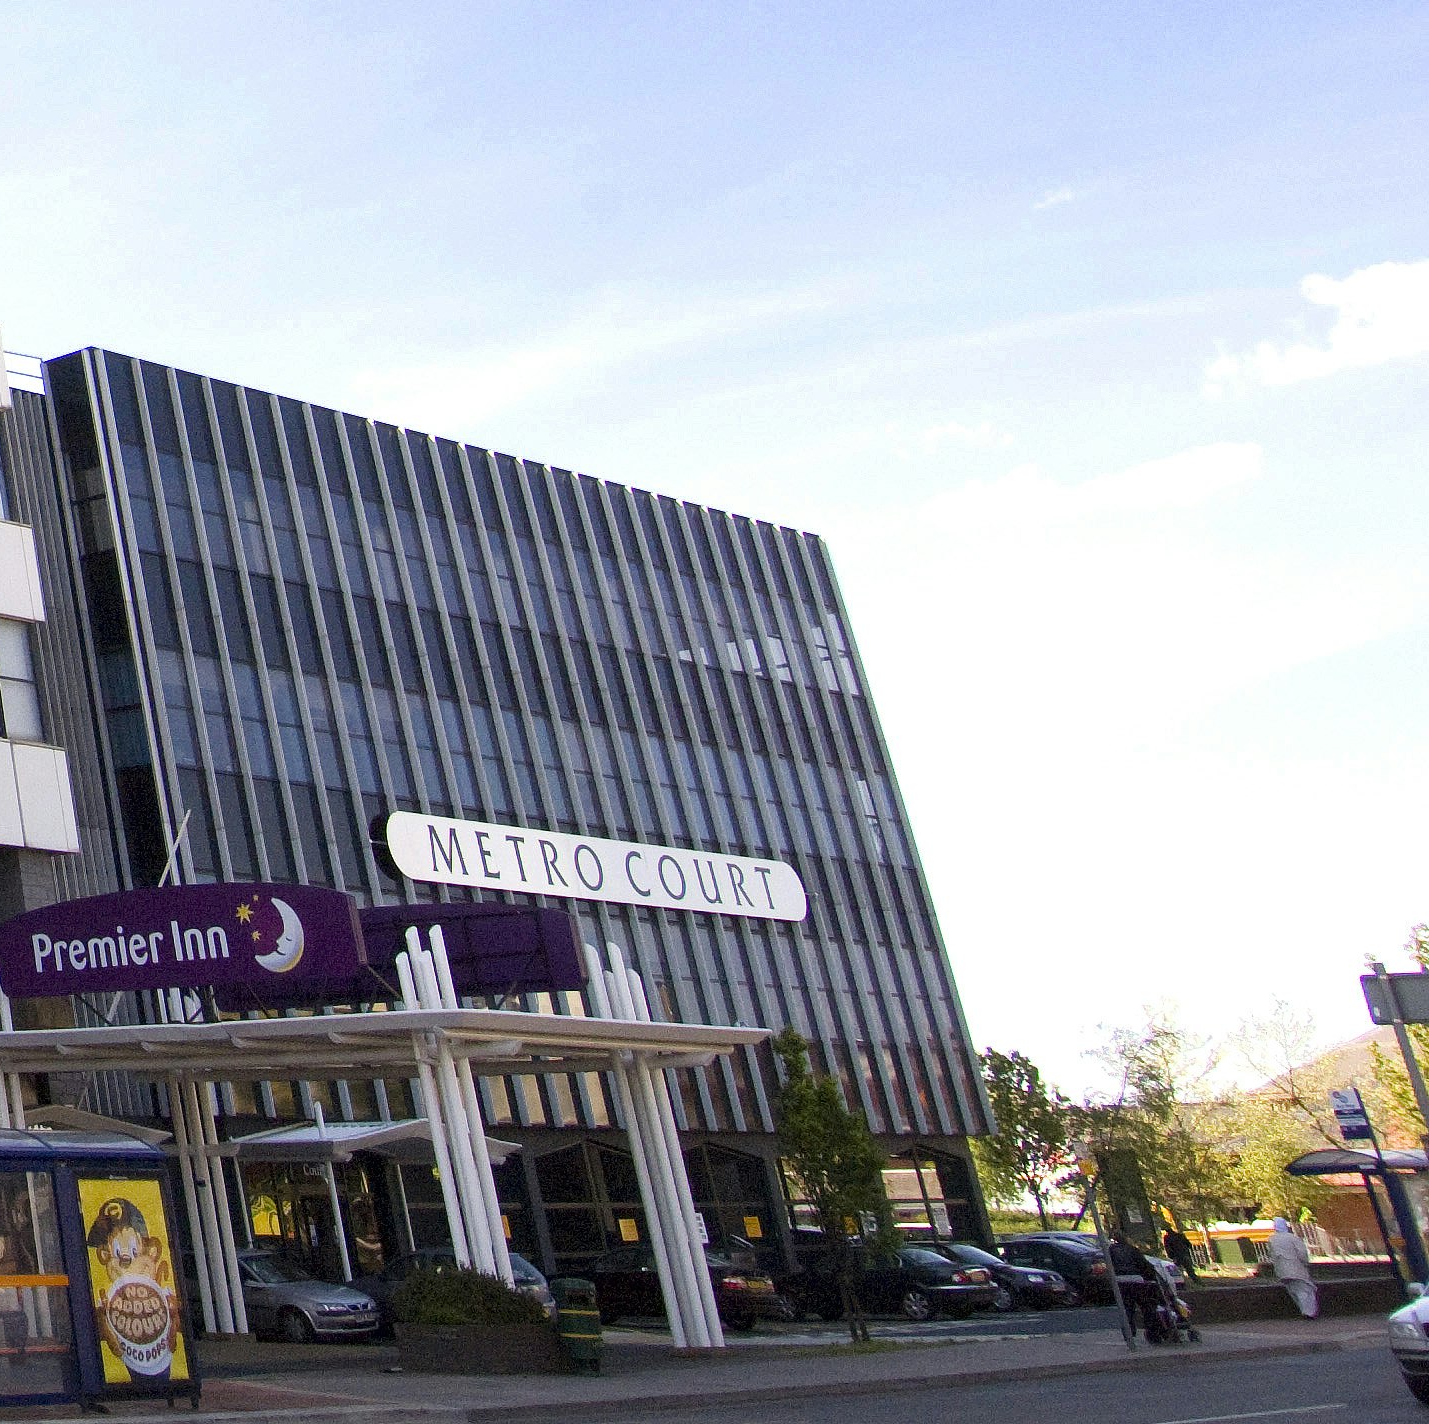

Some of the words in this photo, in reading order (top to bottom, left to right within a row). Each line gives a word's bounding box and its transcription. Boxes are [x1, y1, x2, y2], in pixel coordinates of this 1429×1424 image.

[427, 823, 604, 892] METRO
[625, 850, 776, 910] COURT
[31, 925, 164, 973] Premier
[170, 920, 230, 962] Inn
[125, 1286, 148, 1298] NO
[112, 1297, 161, 1314] ADDED
[121, 1341, 145, 1362] COCO
[145, 1338, 167, 1362] POPS
